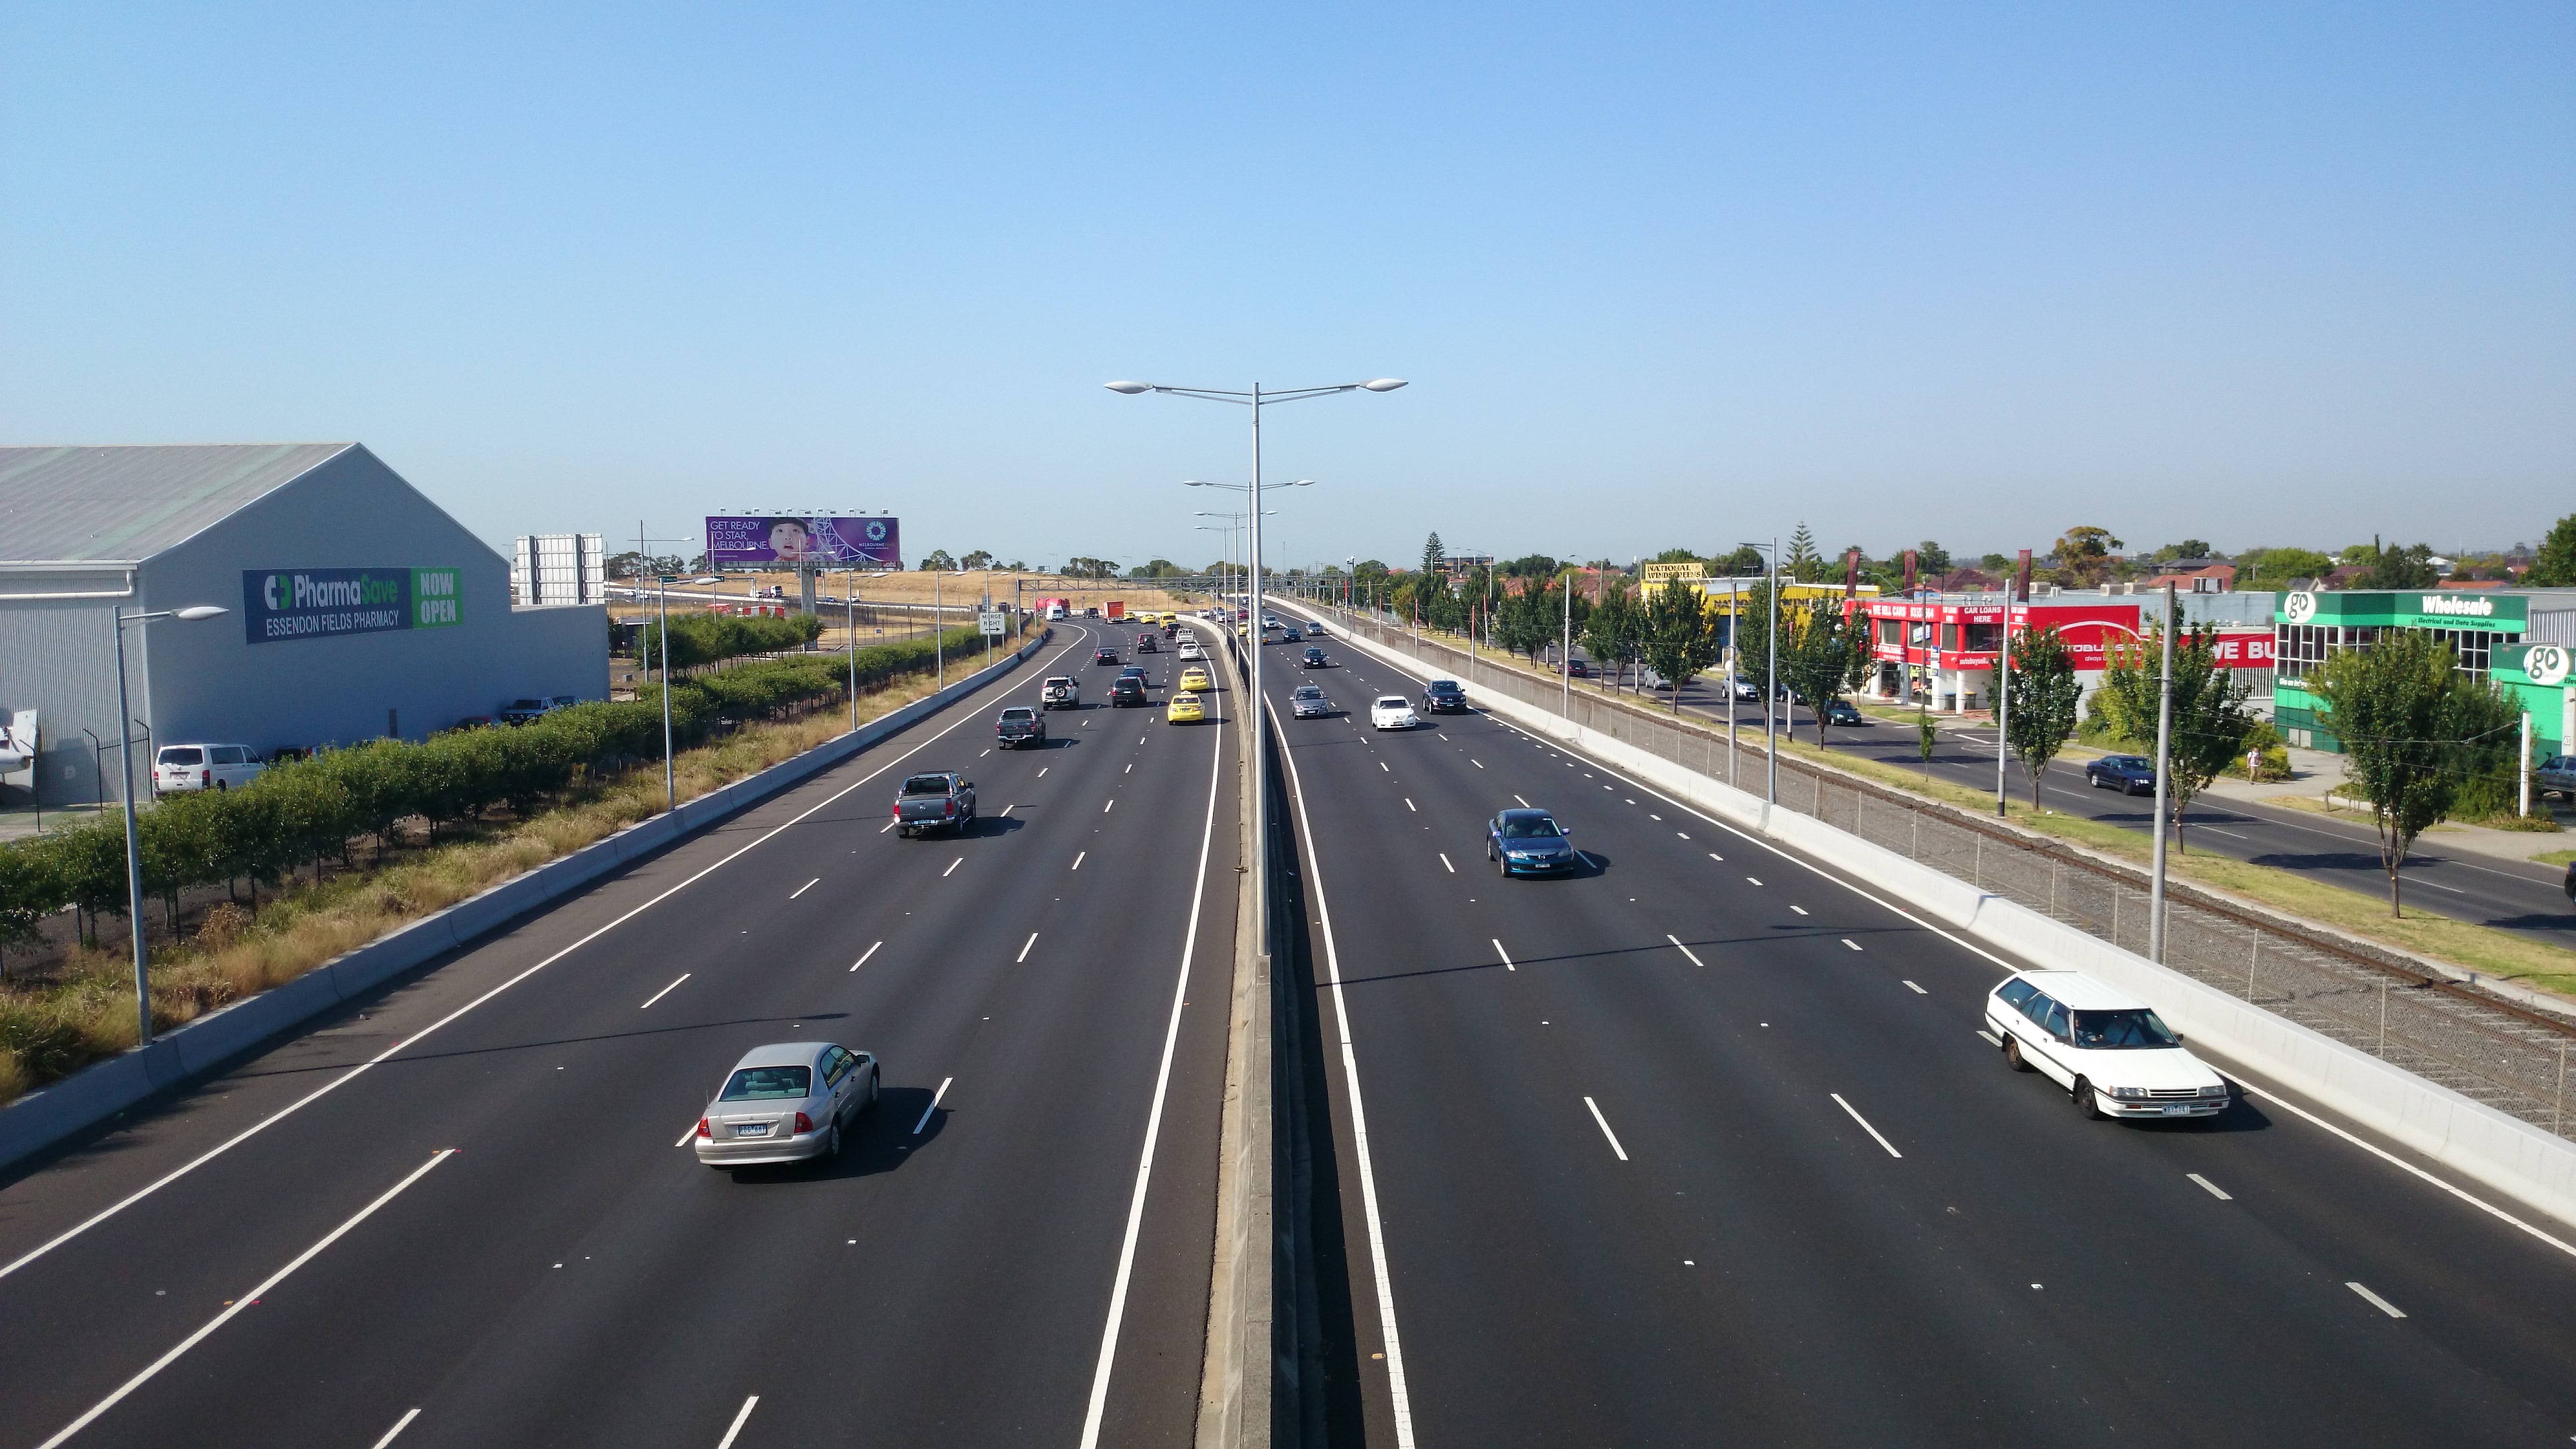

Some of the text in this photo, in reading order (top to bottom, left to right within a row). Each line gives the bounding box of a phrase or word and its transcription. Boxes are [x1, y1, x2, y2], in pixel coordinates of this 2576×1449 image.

[710, 521, 760, 530] GET READY
[710, 531, 749, 541] TO STAR,
[713, 540, 769, 550] MELBOURNE.
[294, 573, 398, 608] PharmaSave
[420, 573, 453, 596] NOW
[420, 600, 456, 624] OPEN
[1872, 605, 1881, 615] WE
[1882, 605, 1892, 616] SELL
[1892, 606, 1907, 617] CARS
[2288, 593, 2309, 620] go
[2422, 596, 2492, 616] Wholesale
[266, 609, 398, 637] ESSENDON FIELDS PHARMACY
[2418, 617, 2441, 625] Electrical
[2455, 619, 2469, 627] Data
[2470, 620, 2496, 629] Supplies
[2213, 641, 2239, 659] WE
[2529, 647, 2559, 680] go
